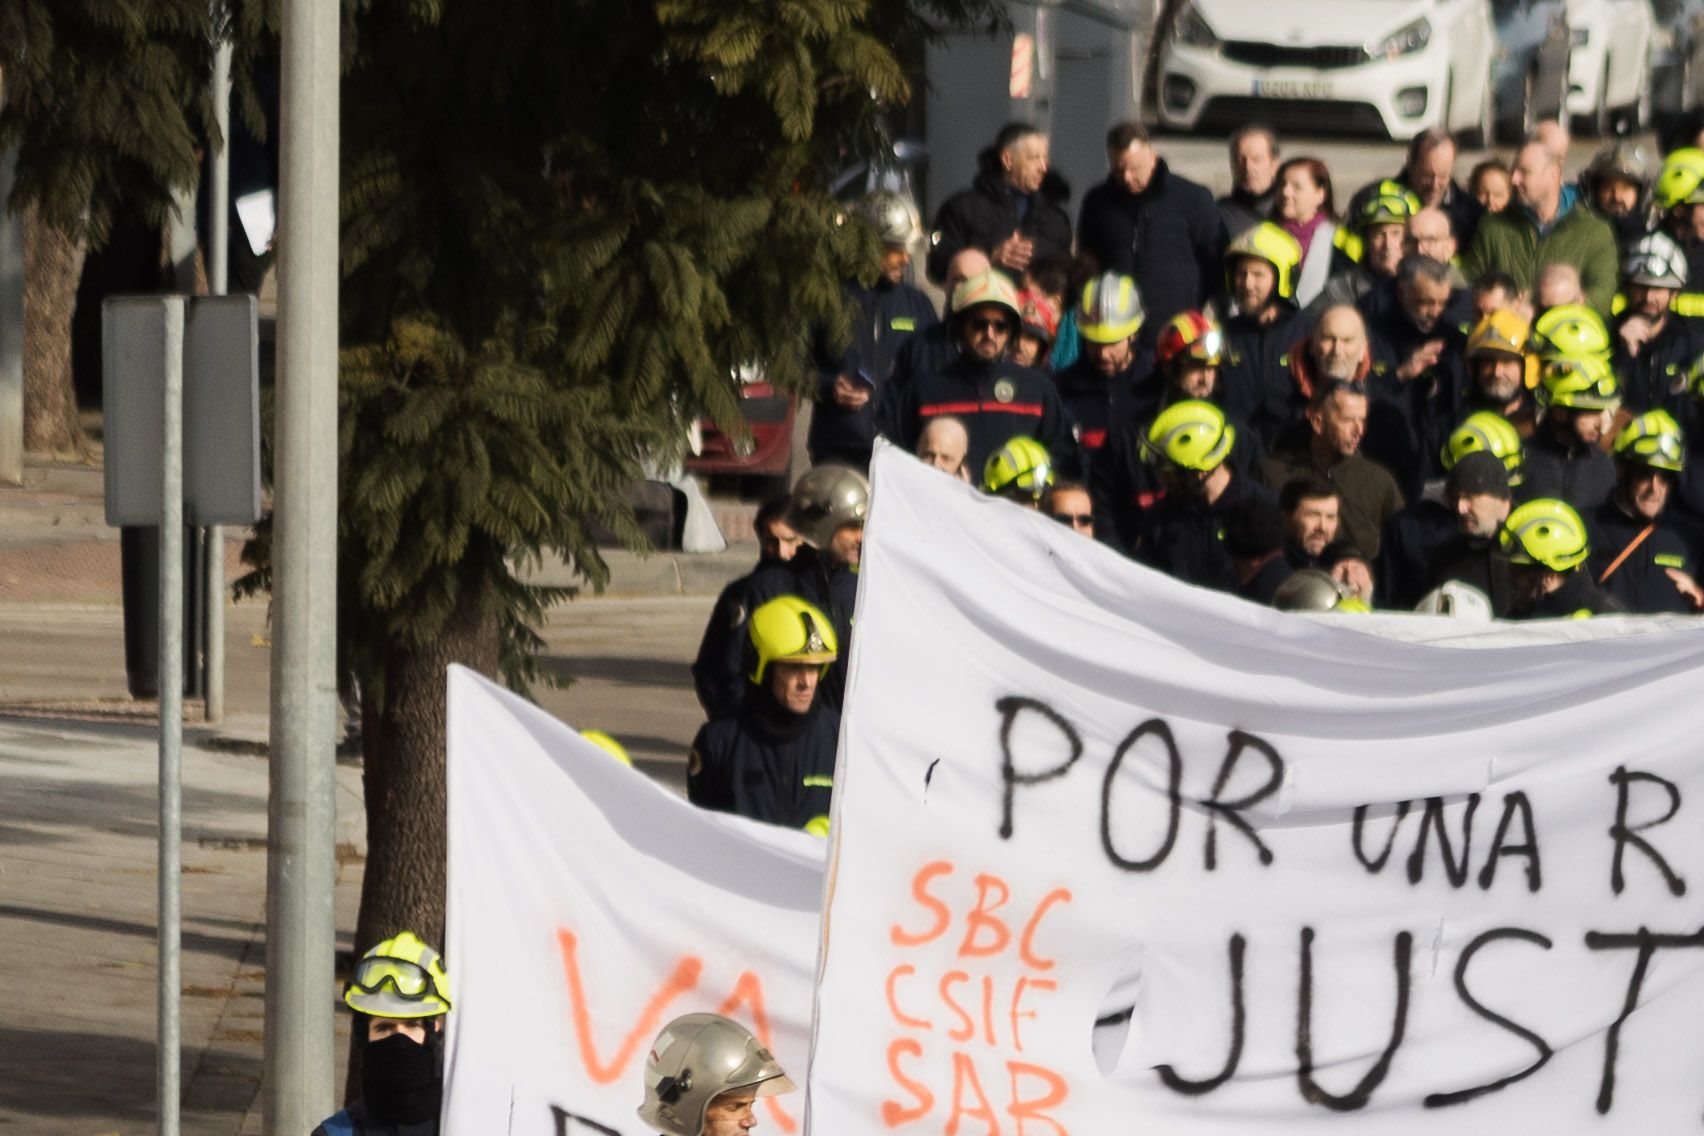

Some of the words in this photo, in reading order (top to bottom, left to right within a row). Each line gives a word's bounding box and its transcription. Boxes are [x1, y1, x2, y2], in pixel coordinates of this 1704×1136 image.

[994, 694, 1285, 873] POR
[1351, 790, 1543, 893] UNA
[889, 861, 1074, 973] SBC
[884, 963, 1059, 1052] CSIF
